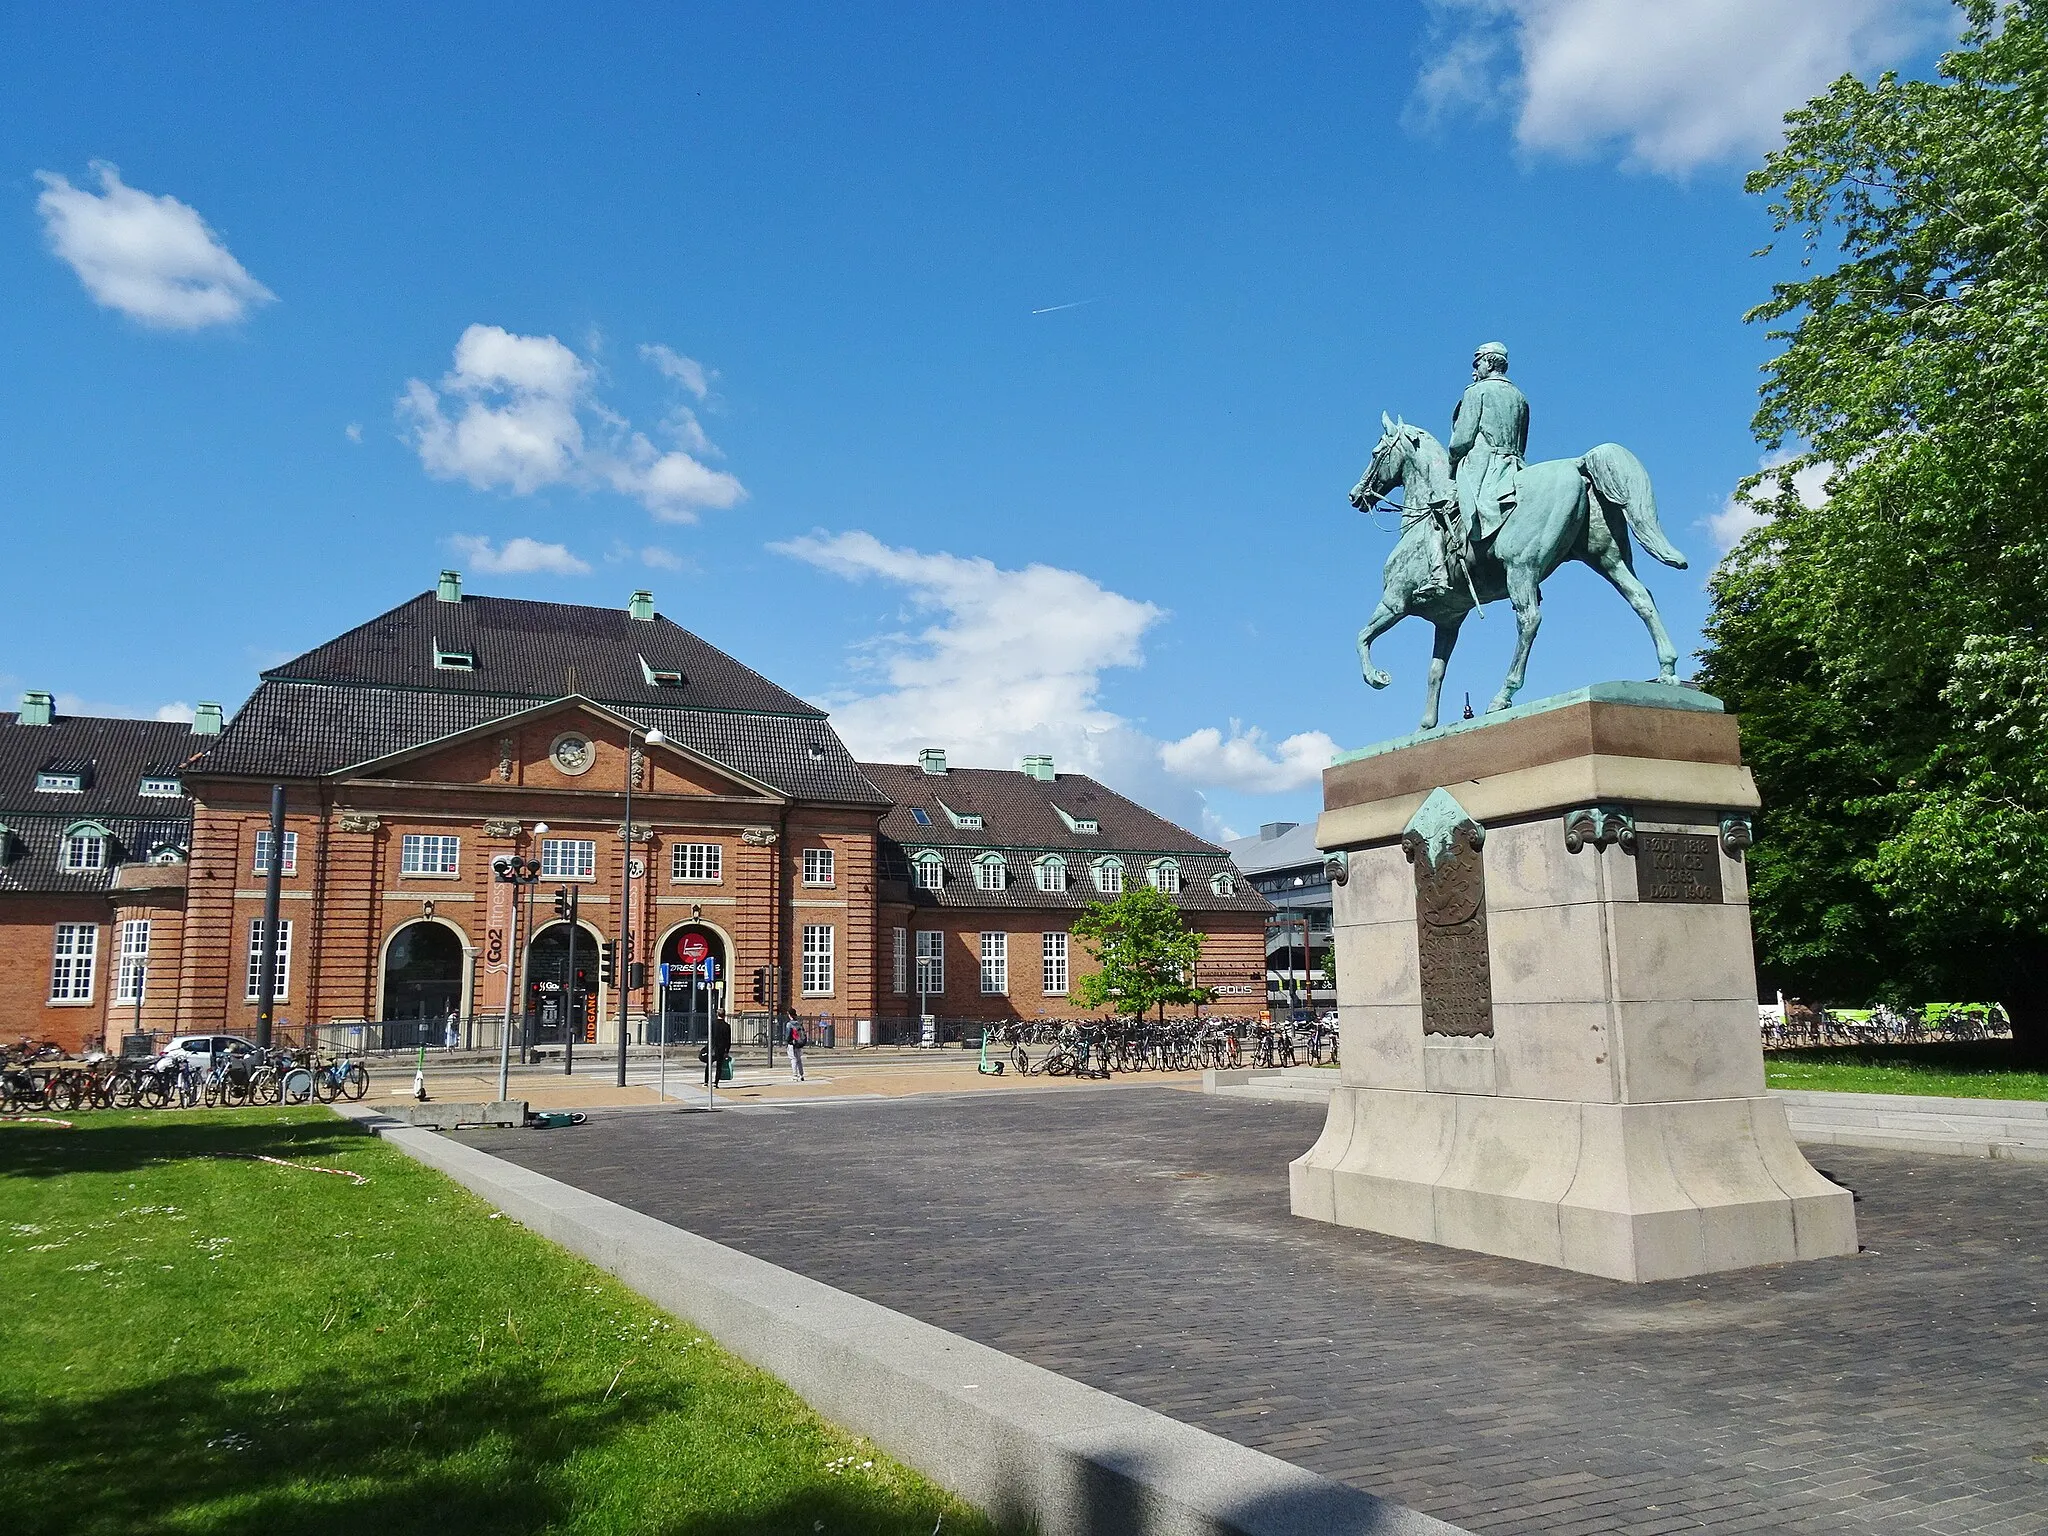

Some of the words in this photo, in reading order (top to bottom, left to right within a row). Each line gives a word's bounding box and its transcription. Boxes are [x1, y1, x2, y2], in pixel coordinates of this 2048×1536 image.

[489, 883, 505, 928] fitness
[487, 929, 503, 963] Go2
[586, 992, 596, 1043] INDGANG
